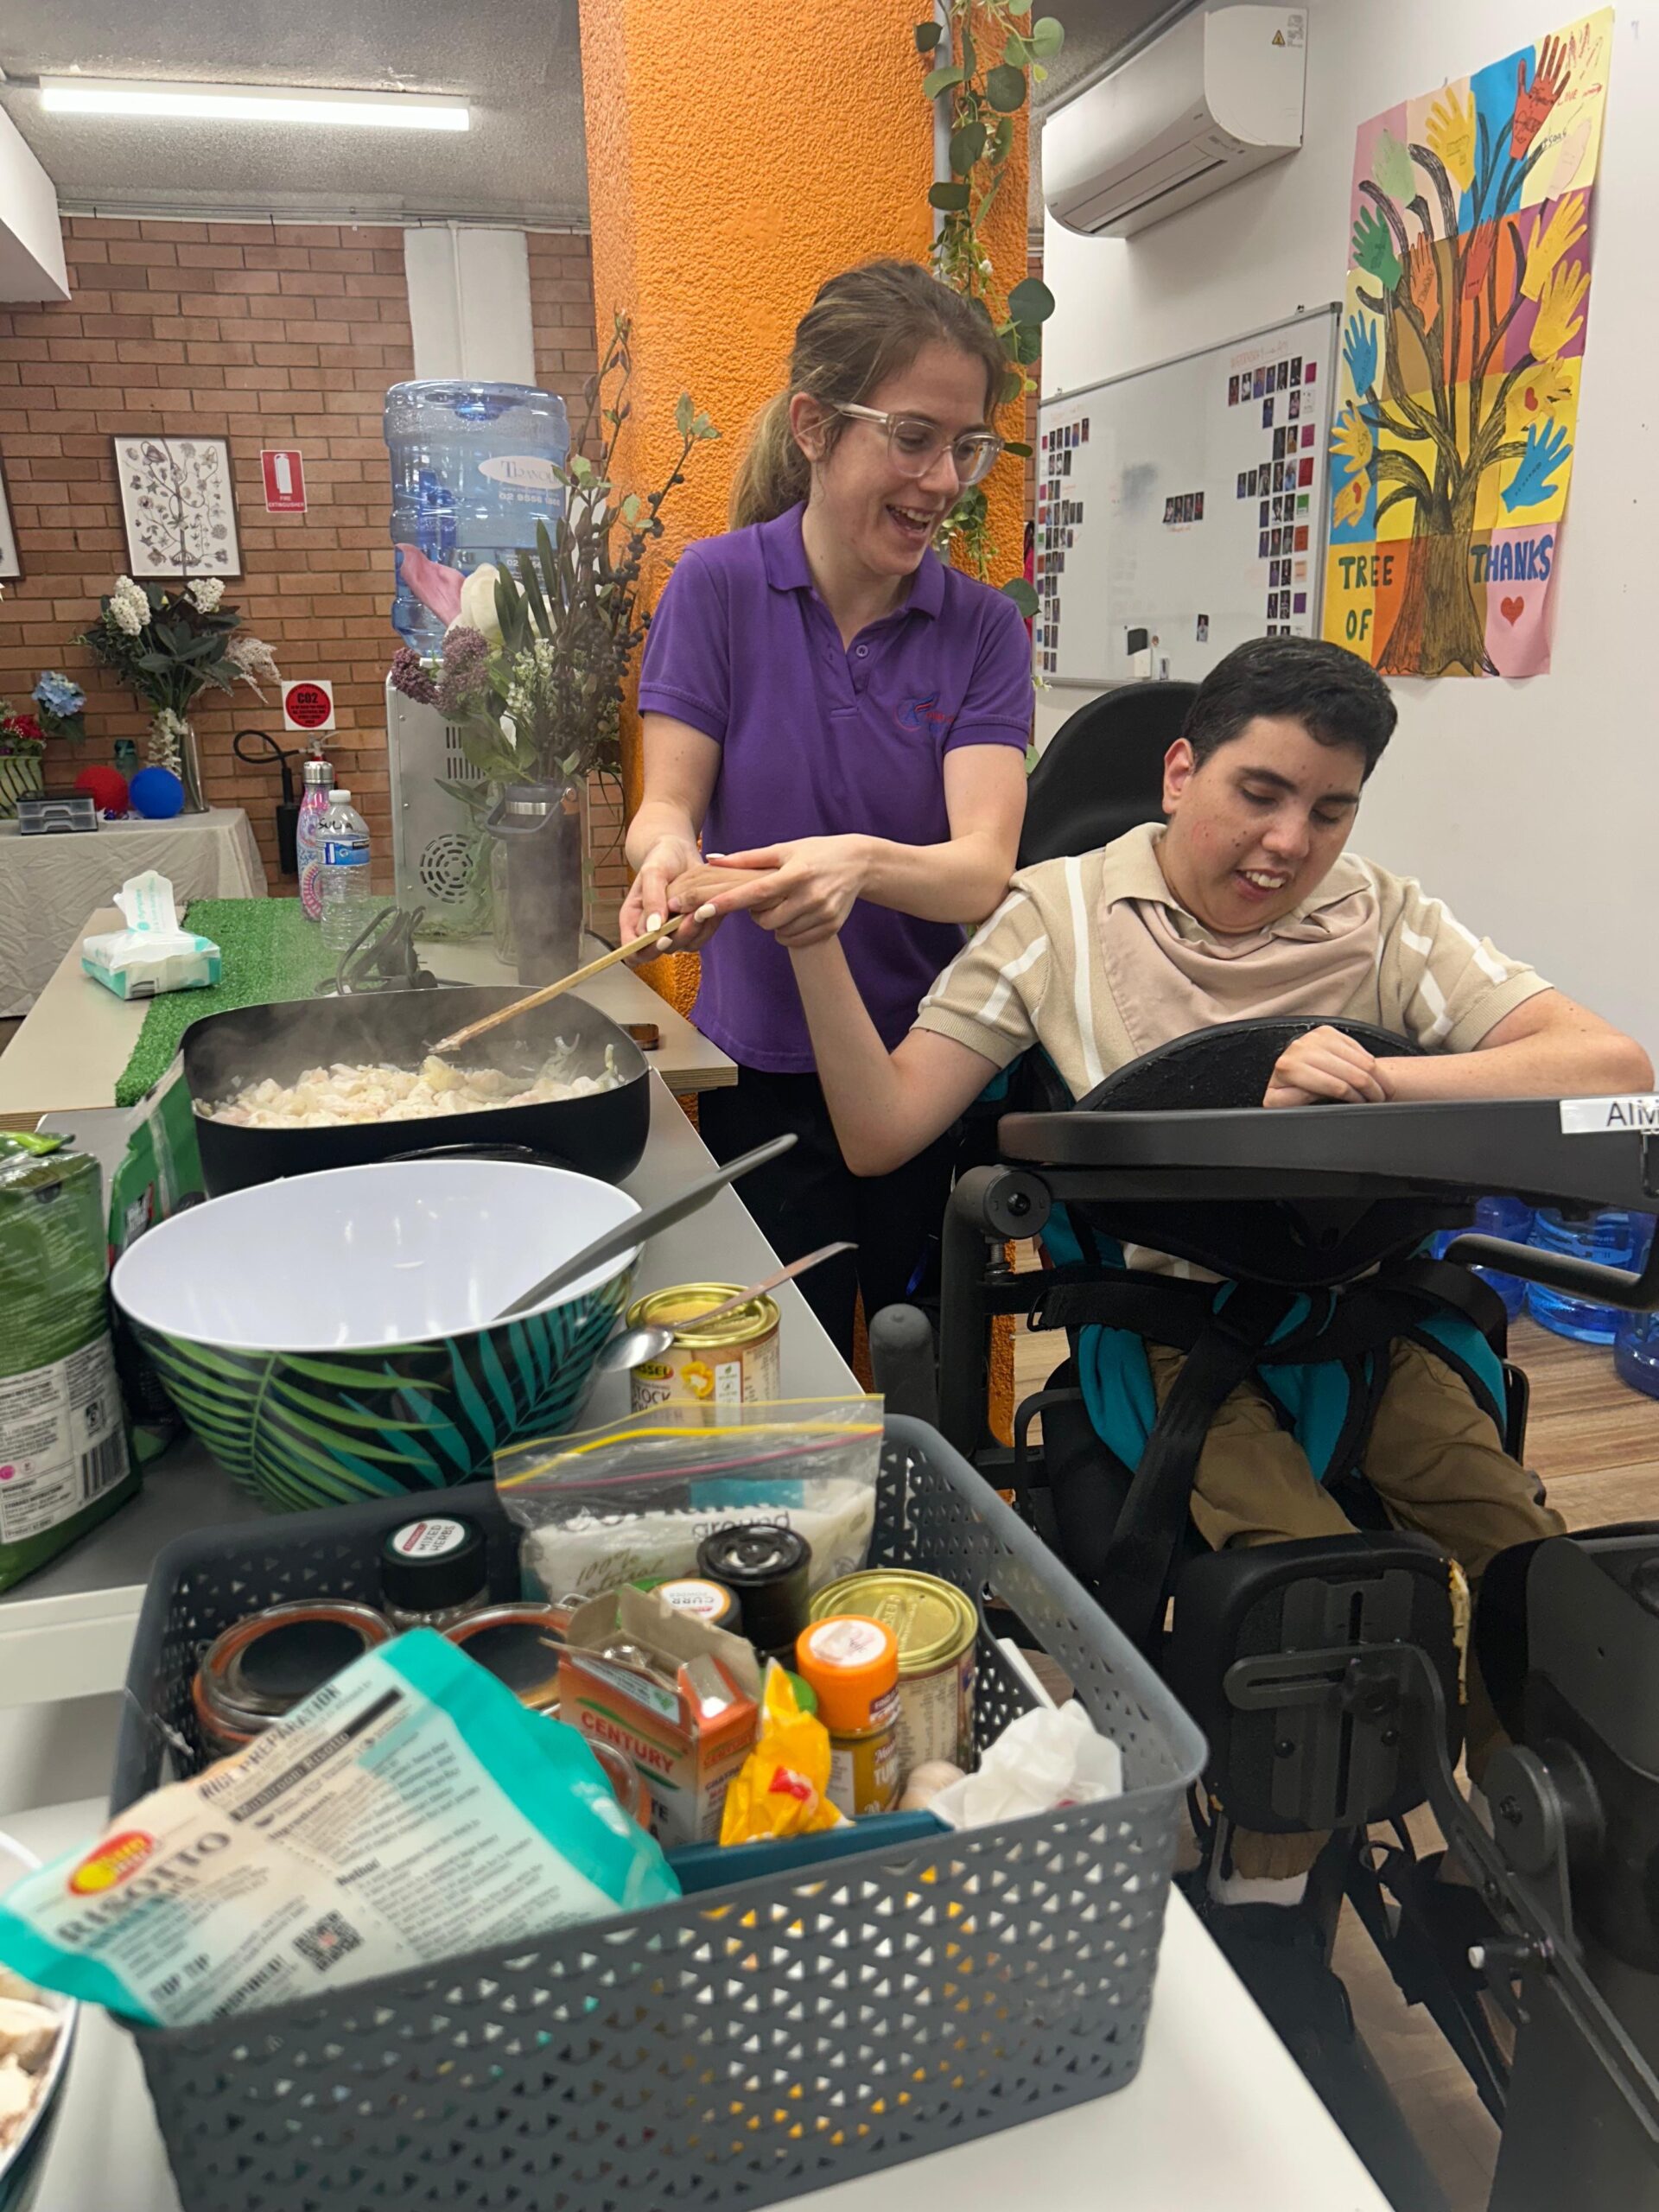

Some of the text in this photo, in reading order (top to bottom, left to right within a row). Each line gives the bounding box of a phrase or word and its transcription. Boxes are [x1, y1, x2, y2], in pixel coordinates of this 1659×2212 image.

[1338, 556, 1395, 589] TREE
[1471, 534, 1554, 584] THANKS
[1345, 608, 1373, 641] OF
[297, 692, 319, 704] CO2
[417, 1524, 442, 1551] MIXED
[430, 1525, 456, 1551] HERBS
[671, 1596, 715, 1605] CURR
[239, 1684, 341, 1773] PREPARATION
[581, 1711, 675, 1774] CENTURY
[238, 1732, 351, 1817] Mushroom Risotto
[57, 1832, 231, 1943] RISOTTO
[335, 1858, 381, 1887] Method
